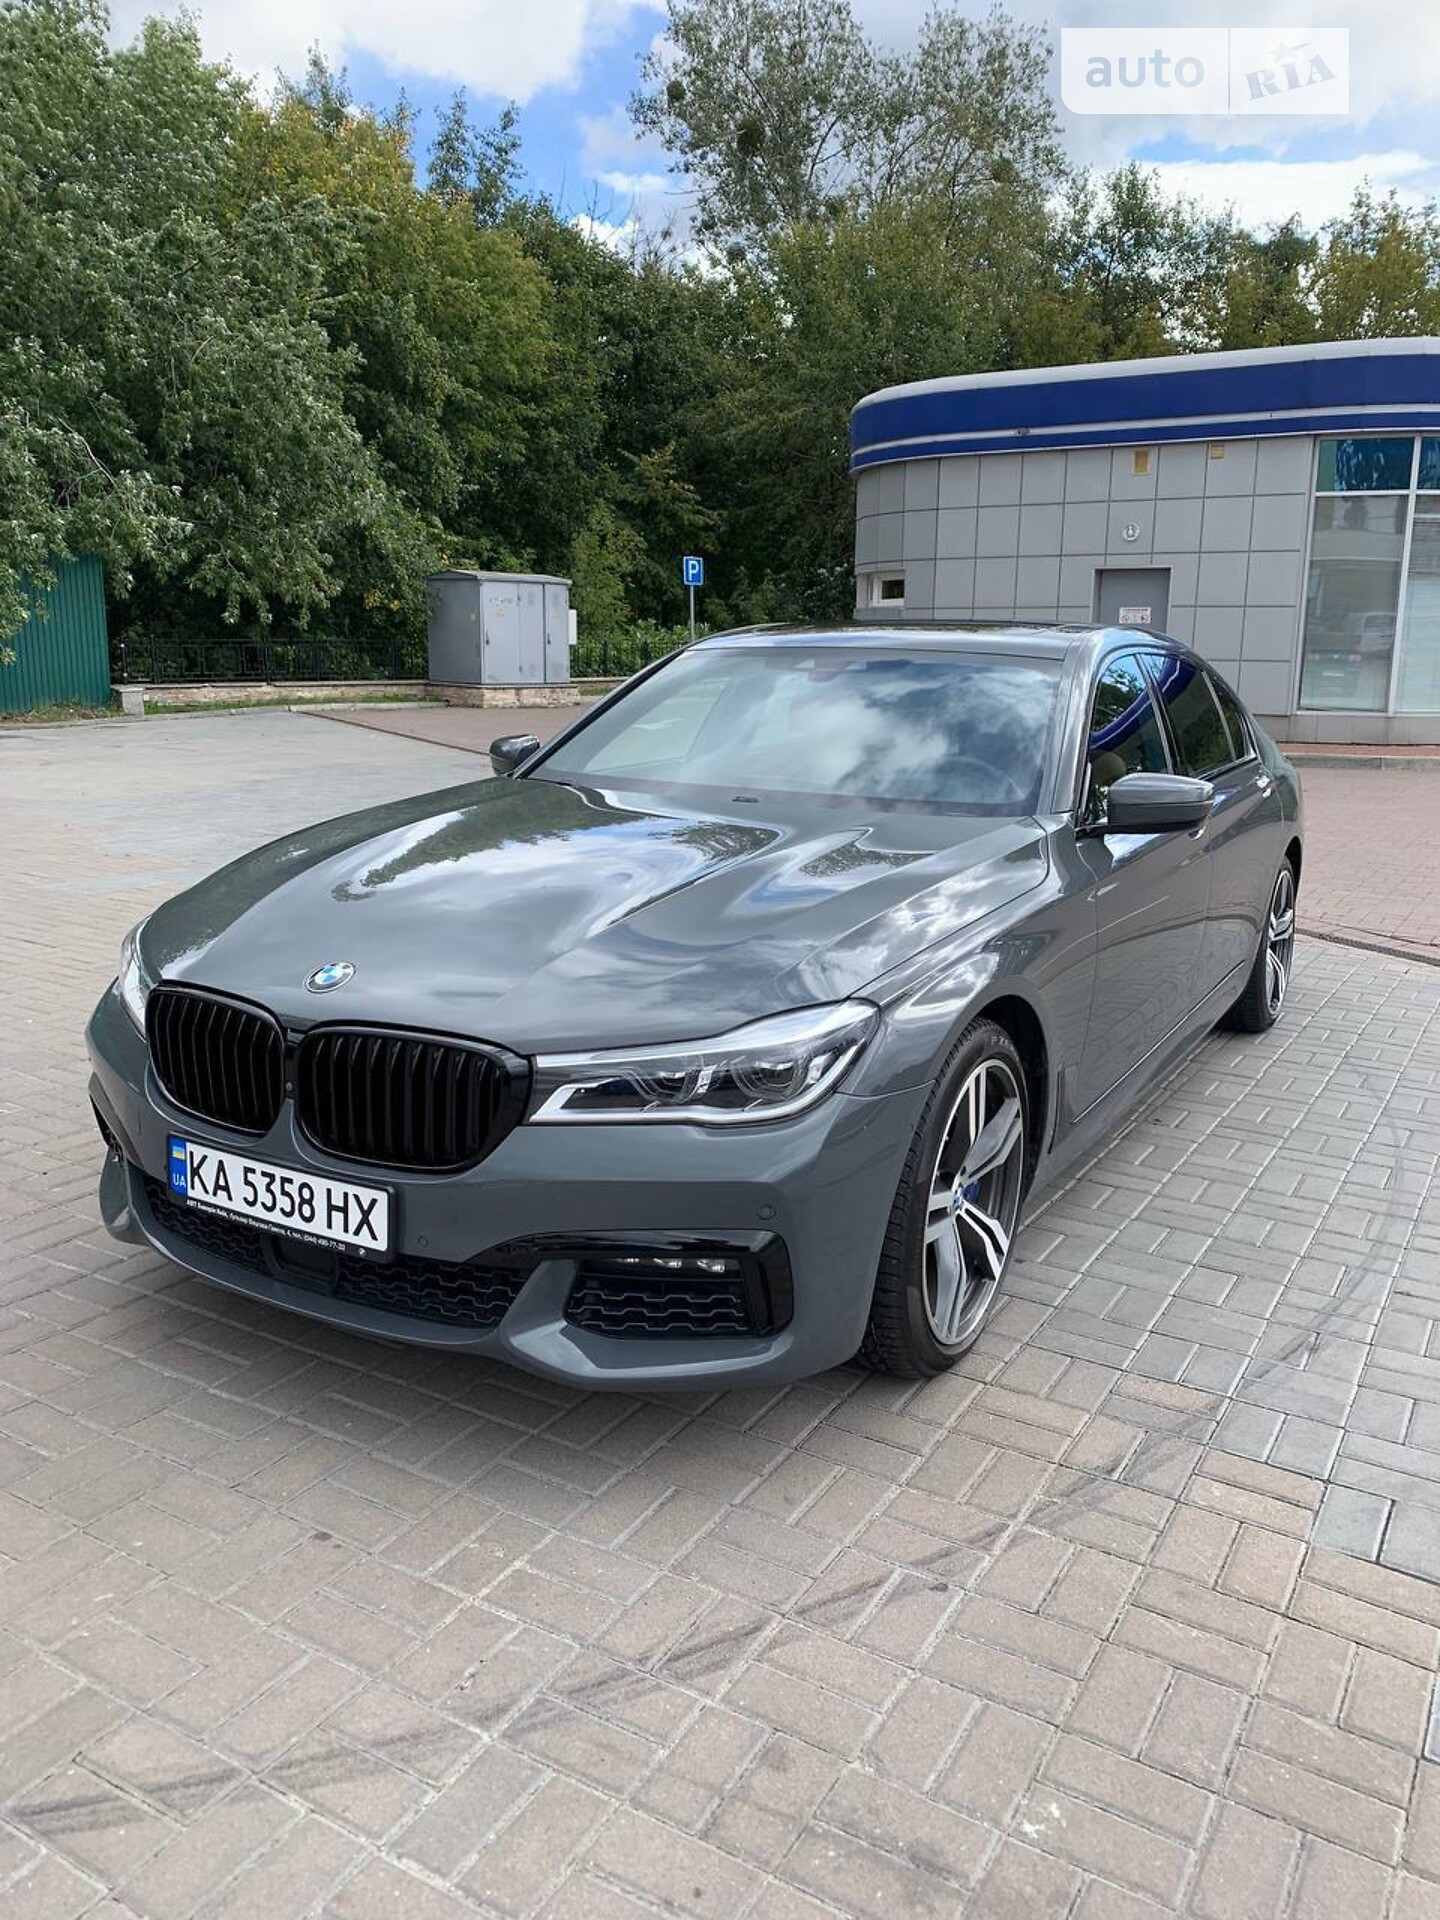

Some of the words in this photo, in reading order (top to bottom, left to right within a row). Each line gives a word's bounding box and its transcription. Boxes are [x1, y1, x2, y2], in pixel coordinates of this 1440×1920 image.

[688, 560, 699, 581] P
[173, 1174, 187, 1188] UA
[188, 1150, 234, 1201] KA
[242, 1165, 316, 1224] 5358
[326, 1187, 379, 1241] HX
